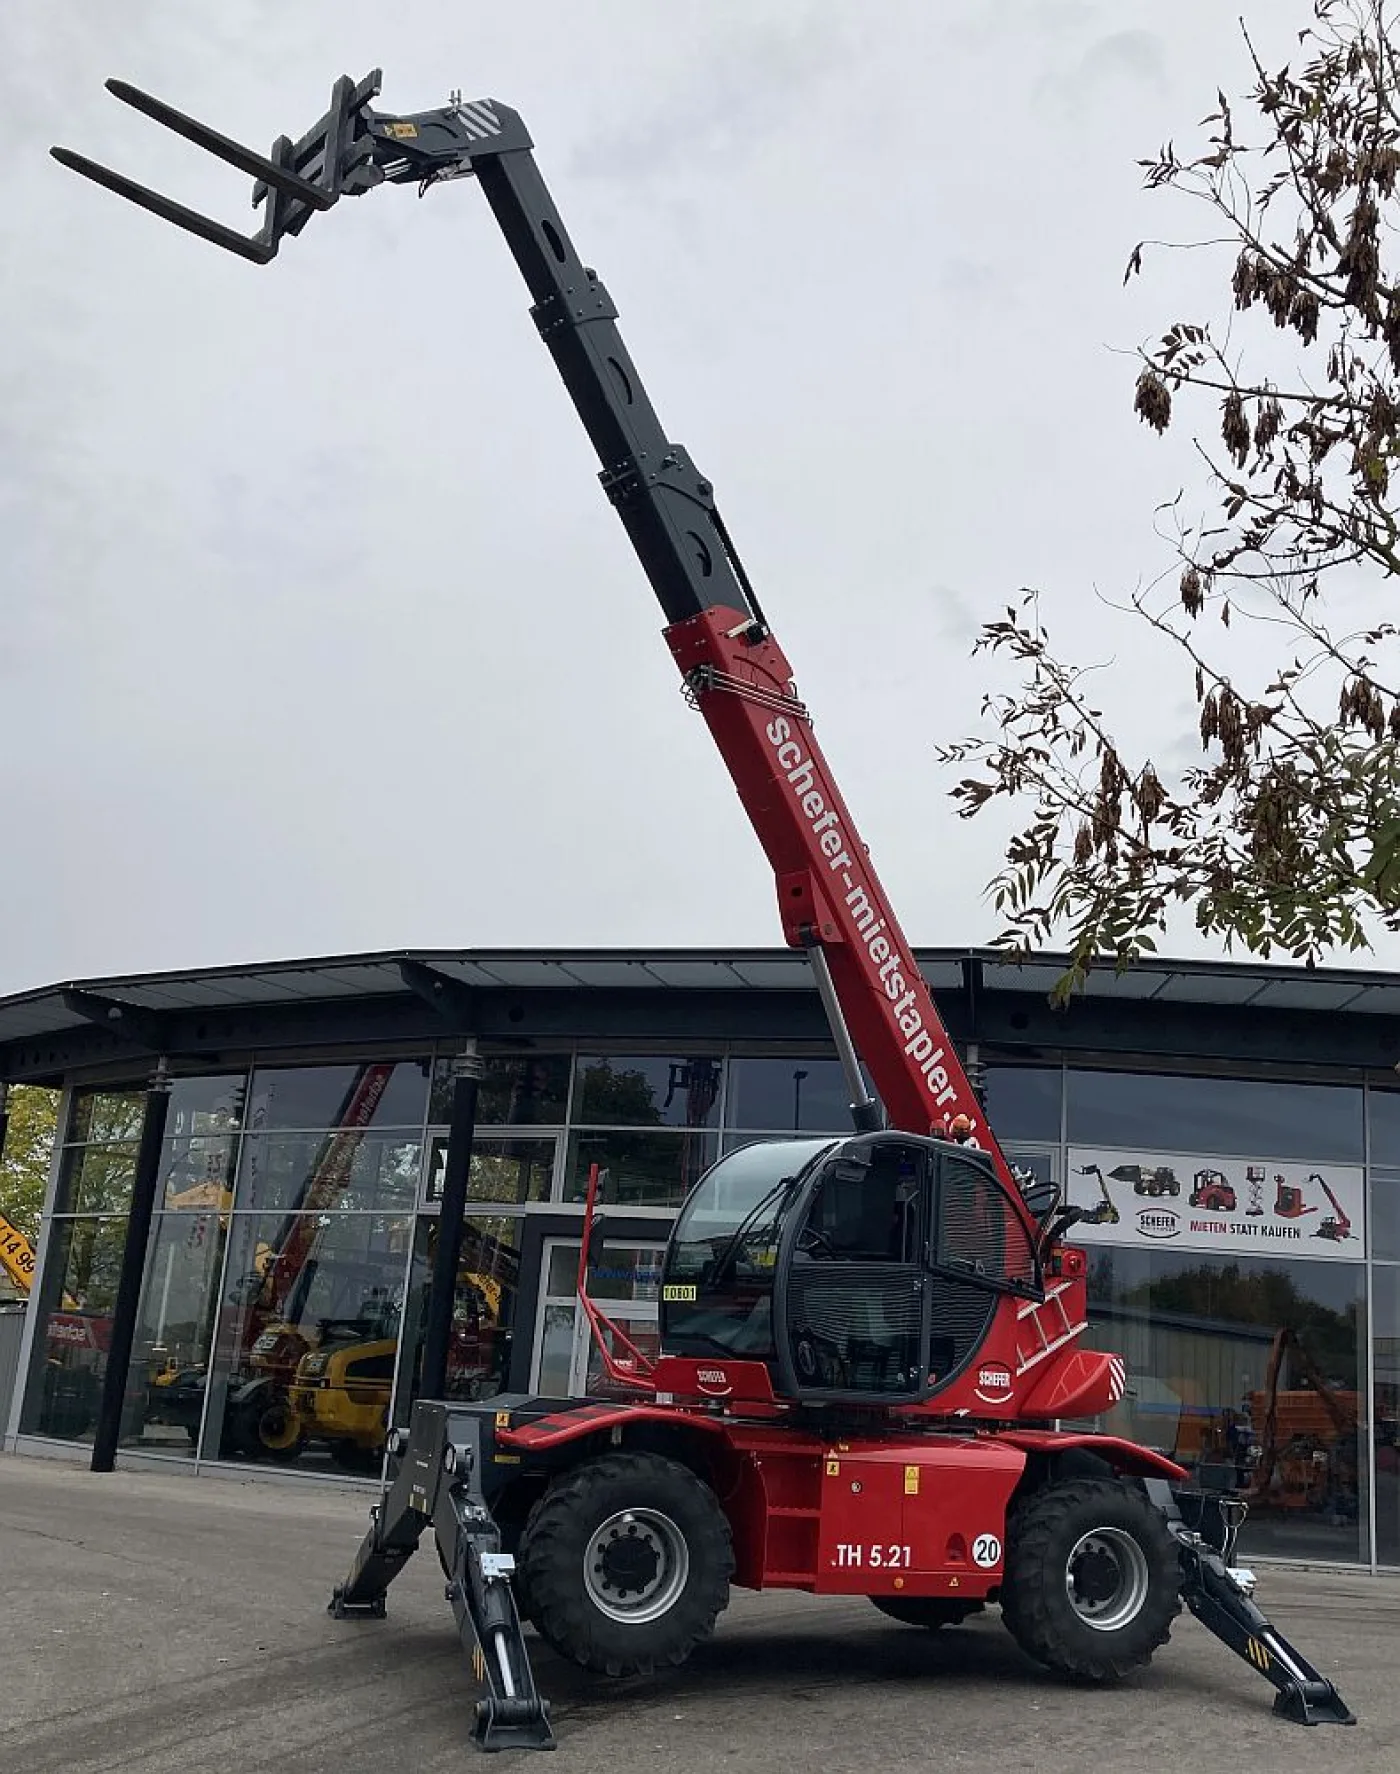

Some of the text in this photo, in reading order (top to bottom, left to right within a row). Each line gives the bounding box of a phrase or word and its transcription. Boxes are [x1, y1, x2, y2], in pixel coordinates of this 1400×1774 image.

[766, 716, 980, 1150] schefer-mietstapler.
[1140, 1214, 1176, 1227] SCHEFER
[1190, 1220, 1227, 1233] MIETEN
[1229, 1223, 1258, 1236] STATT
[1261, 1225, 1300, 1239] KAUFEN
[979, 1370, 1011, 1387] SCHEFER
[868, 1544, 911, 1567] 5.21
[977, 1539, 999, 1562] 20
